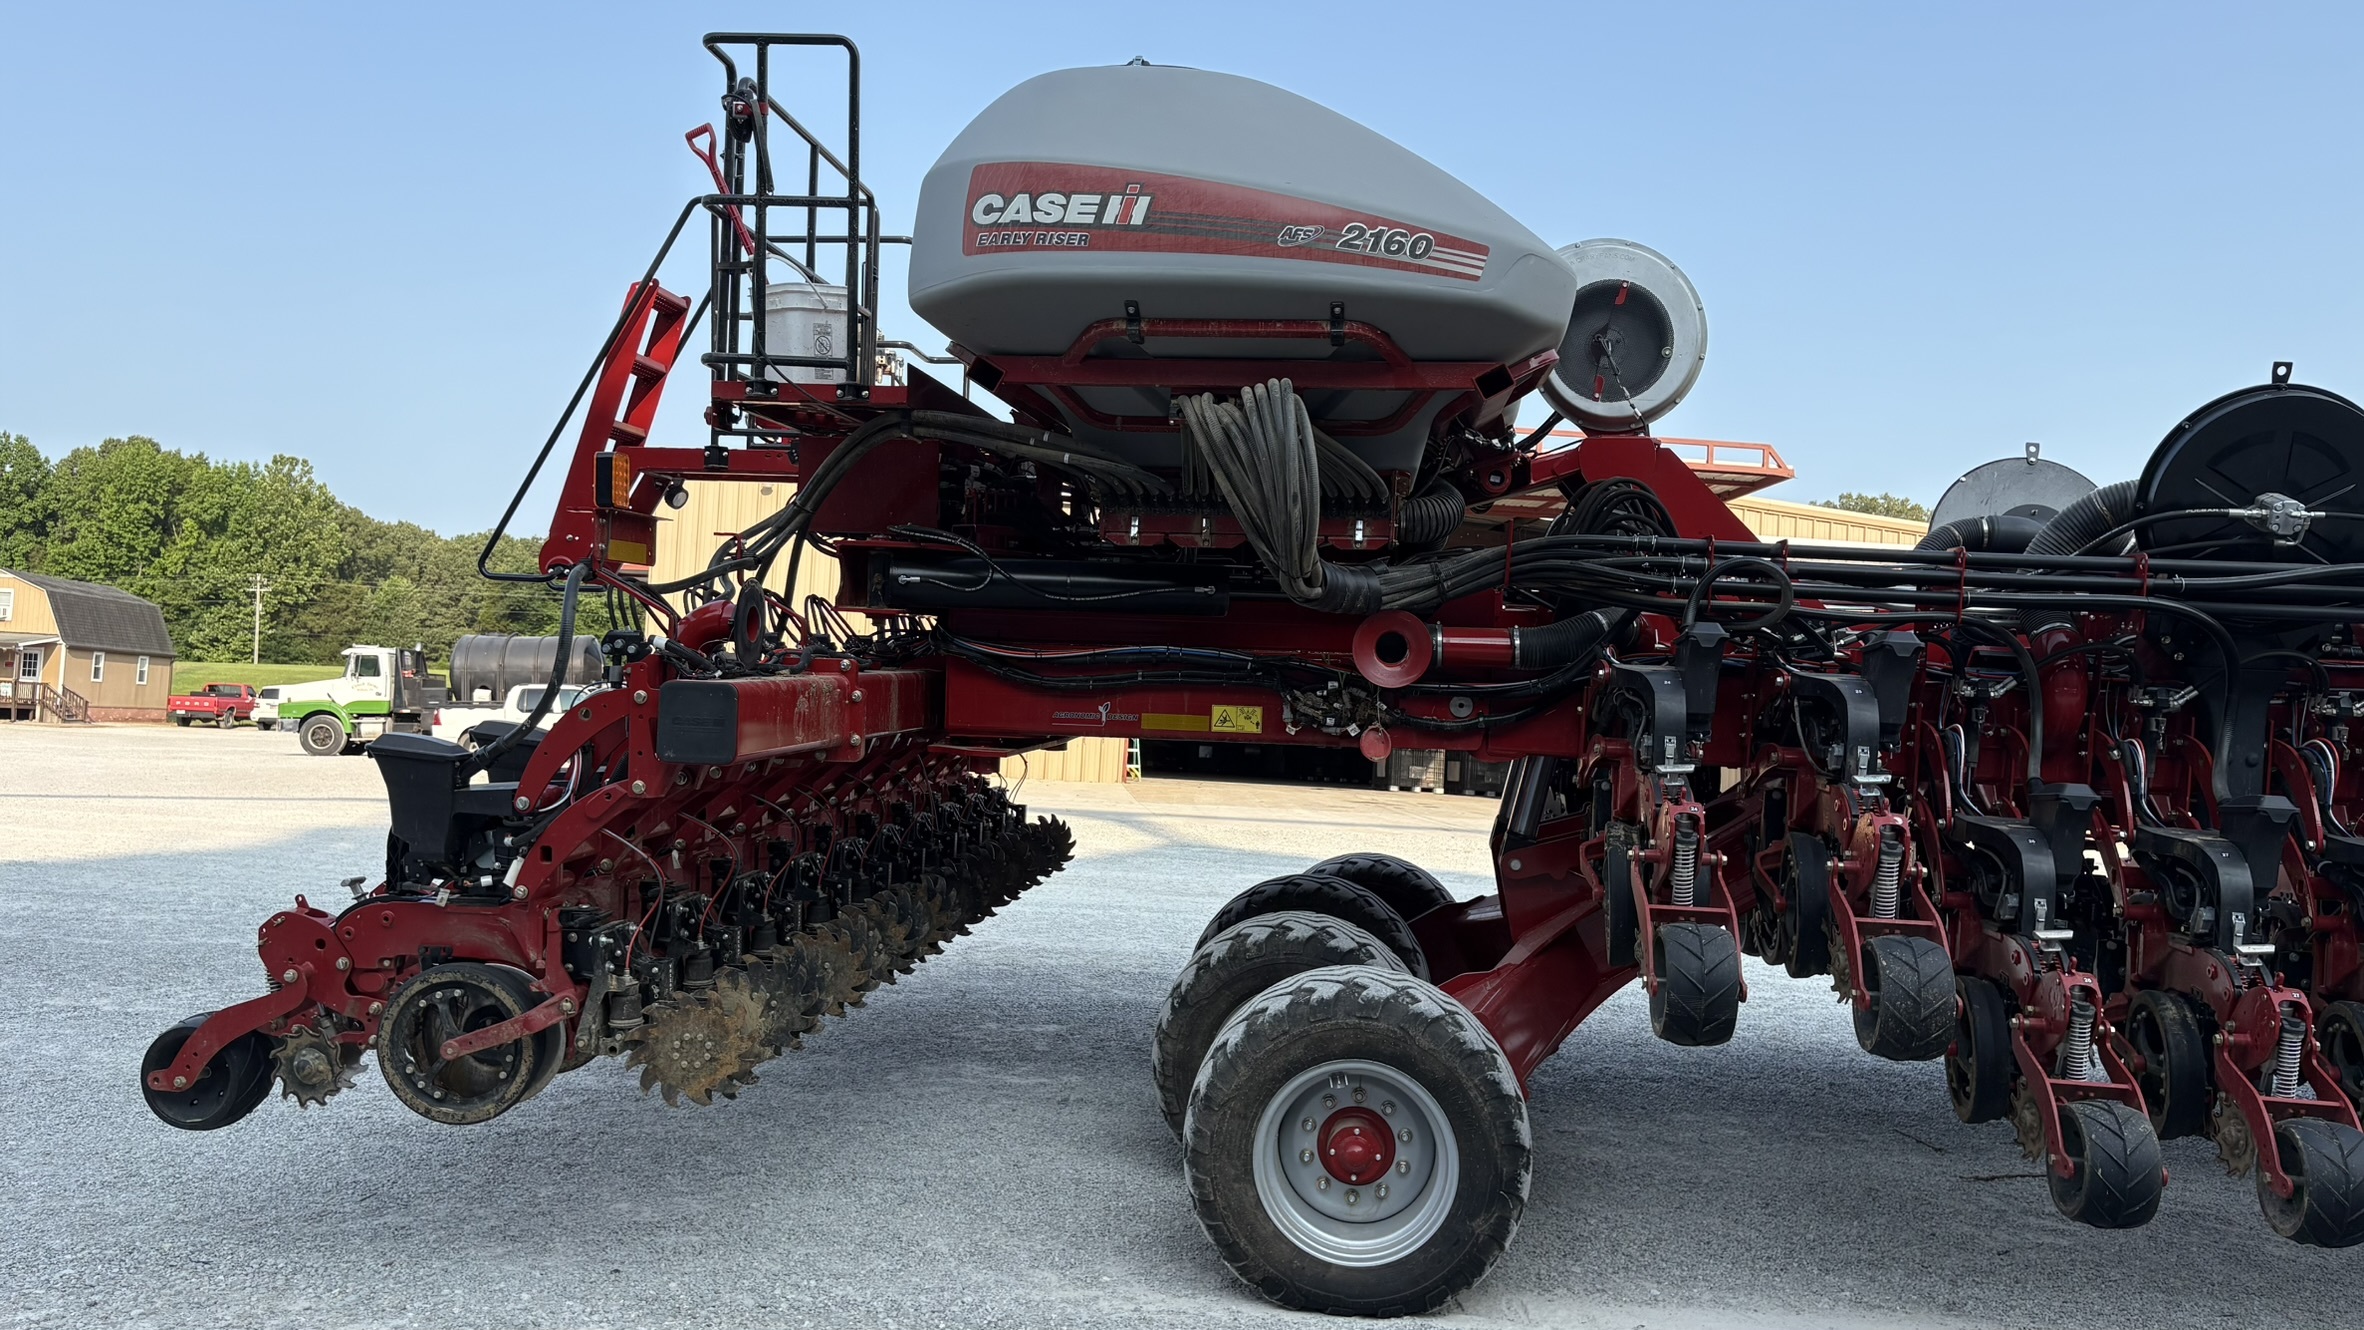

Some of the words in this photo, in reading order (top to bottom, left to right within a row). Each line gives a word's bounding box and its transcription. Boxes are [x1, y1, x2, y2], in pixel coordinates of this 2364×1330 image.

[972, 192, 1101, 225] CASE
[976, 231, 1032, 247] EARLY
[1035, 231, 1090, 247] RISER
[1278, 225, 1318, 242] AFS
[1335, 222, 1435, 261] 2160
[1052, 711, 1101, 719] AGRONOMIC
[1106, 713, 1139, 721] DESIGN
